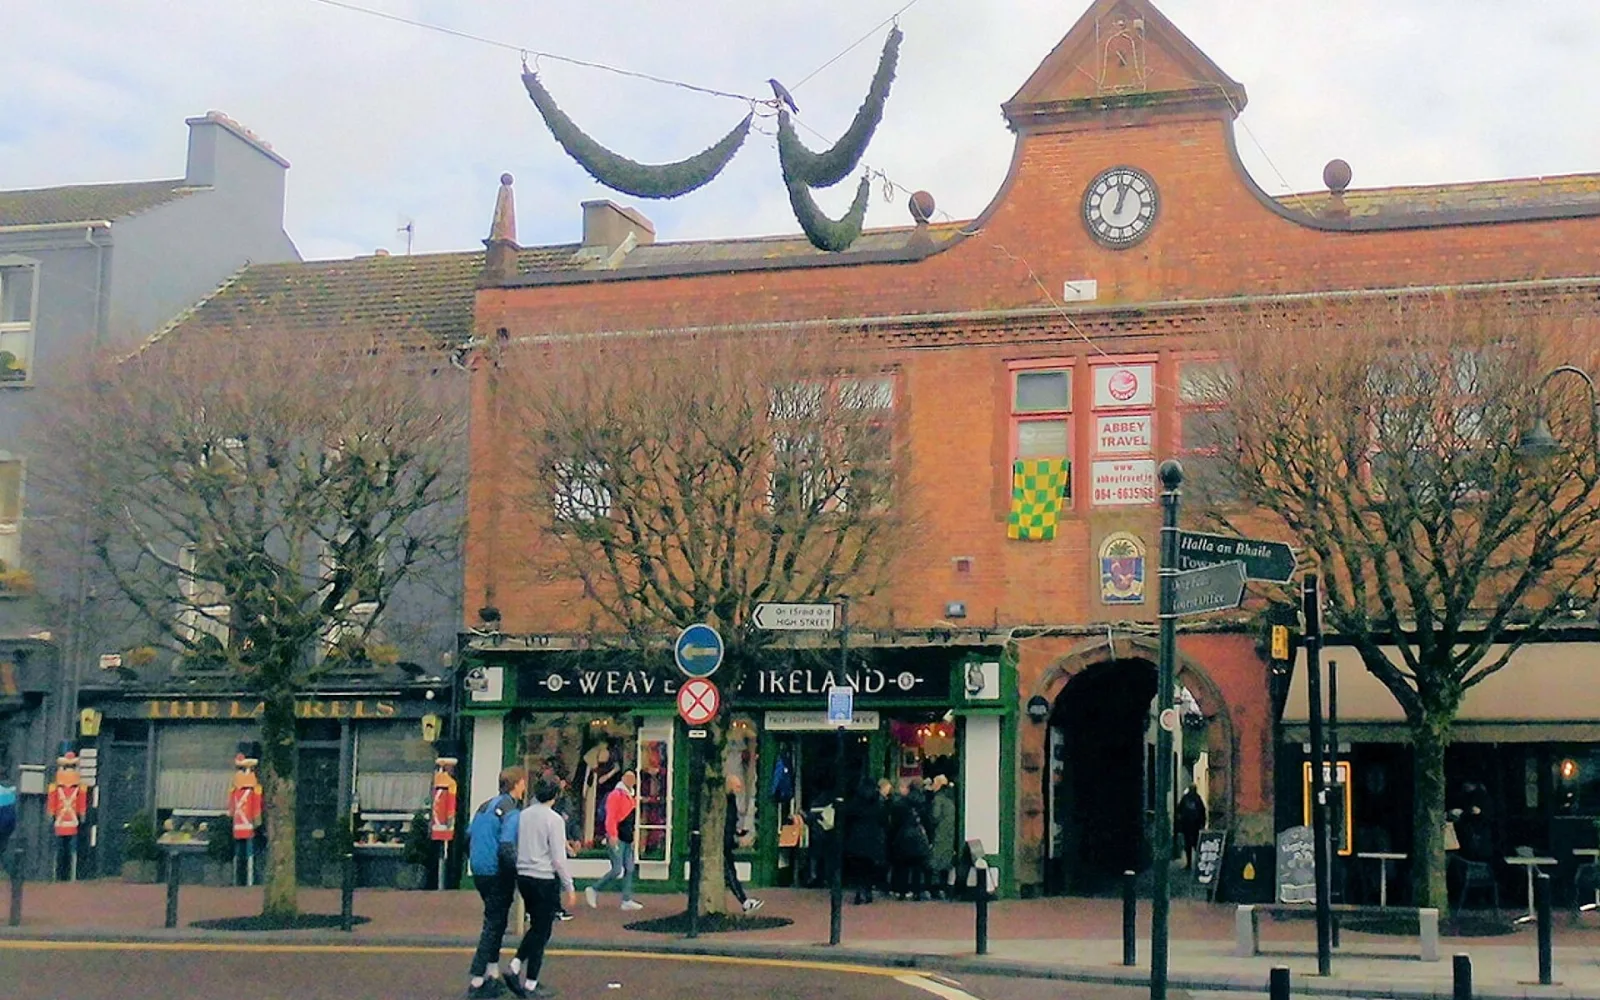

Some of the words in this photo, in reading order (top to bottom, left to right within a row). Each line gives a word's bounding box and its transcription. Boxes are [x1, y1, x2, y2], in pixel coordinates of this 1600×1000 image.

[1103, 422, 1145, 433] ABBEY
[1101, 436, 1148, 447] TRAVEL
[1113, 464, 1136, 472] www.
[1181, 537, 1214, 551] Halla
[1217, 543, 1232, 554] an
[1235, 542, 1272, 558] Bhaile
[799, 618, 830, 627] STREET
[579, 671, 677, 694] WEAVE
[759, 669, 885, 694] IRELAND
[150, 700, 220, 718] THE
[229, 700, 395, 718] LARELS
